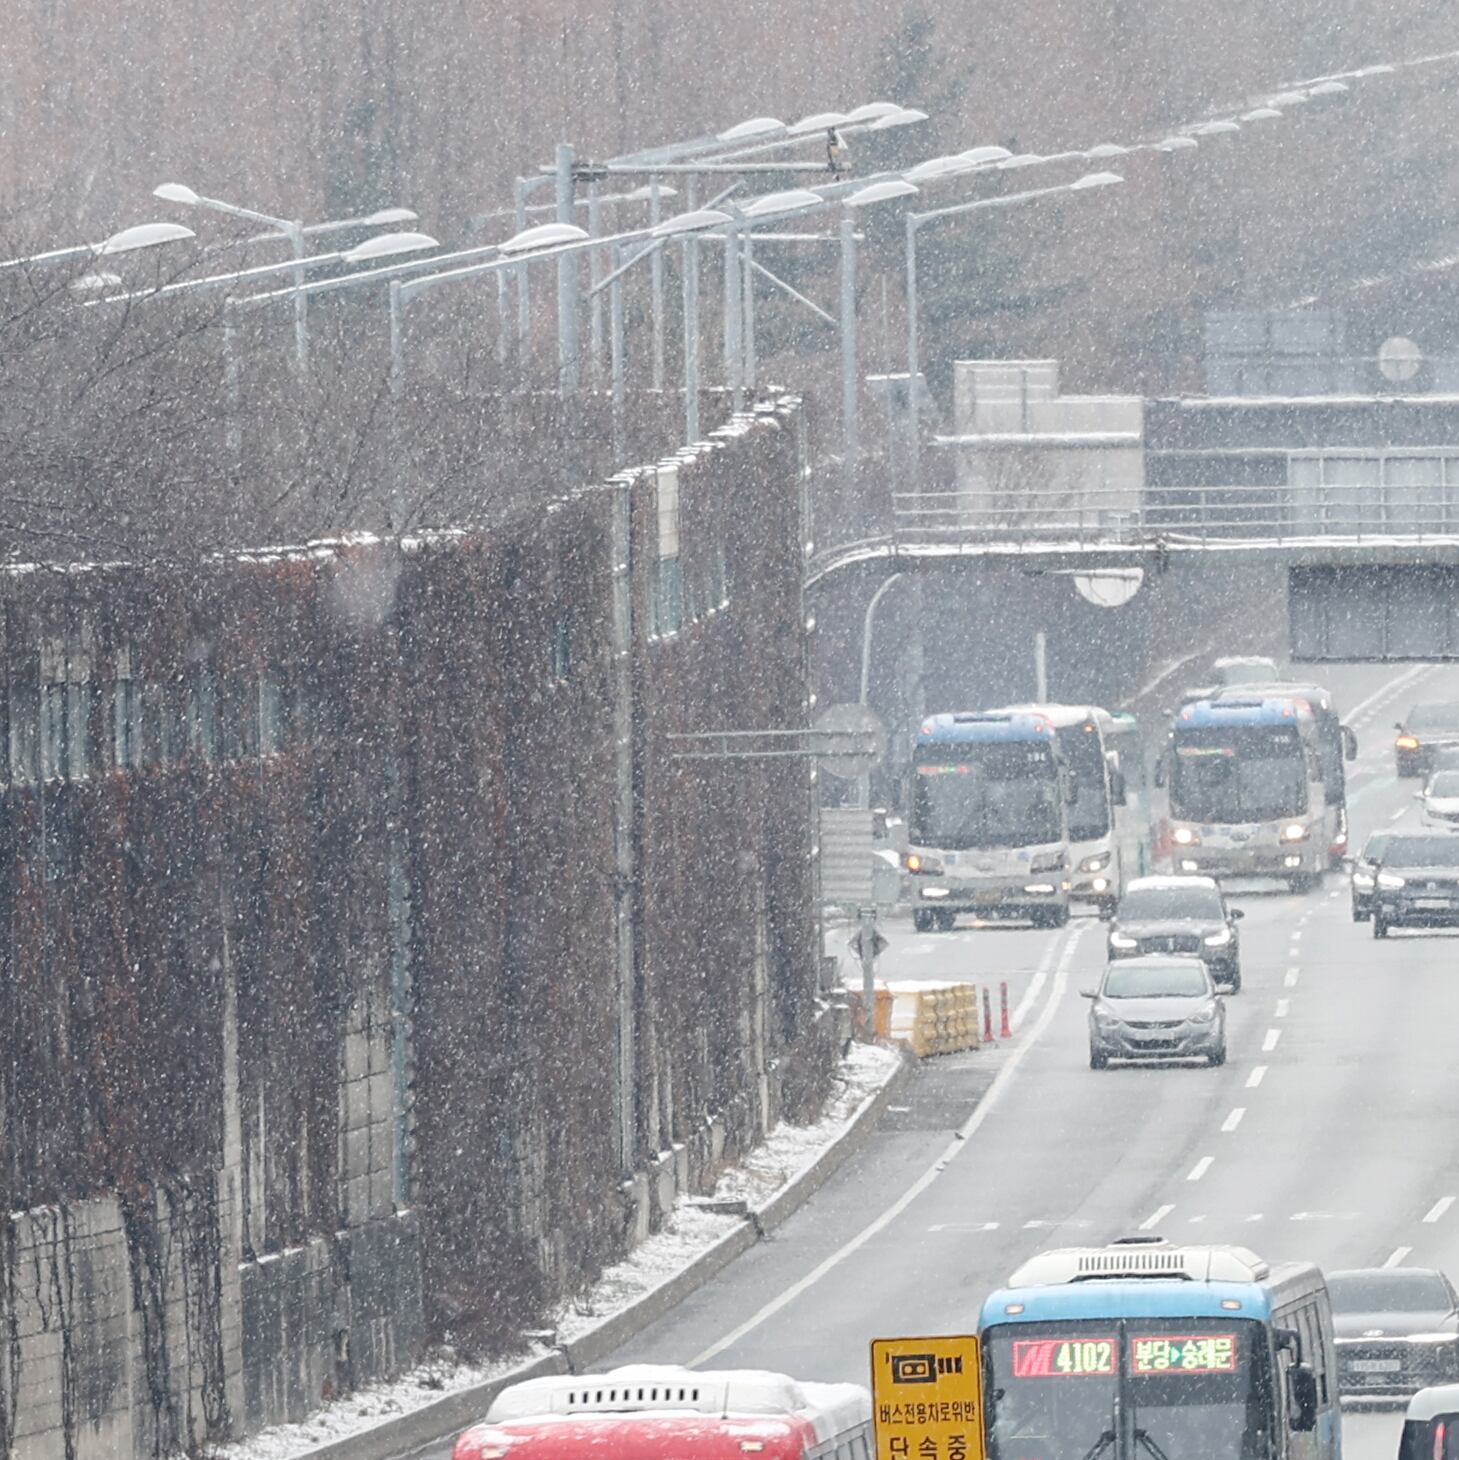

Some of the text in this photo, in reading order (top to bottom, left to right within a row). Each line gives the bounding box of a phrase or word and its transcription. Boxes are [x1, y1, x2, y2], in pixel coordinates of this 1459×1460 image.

[1057, 1342, 1110, 1373] 4102
[1136, 1339, 1232, 1370] 분당 숭례문
[880, 1401, 976, 1425] 버스전용차로위반
